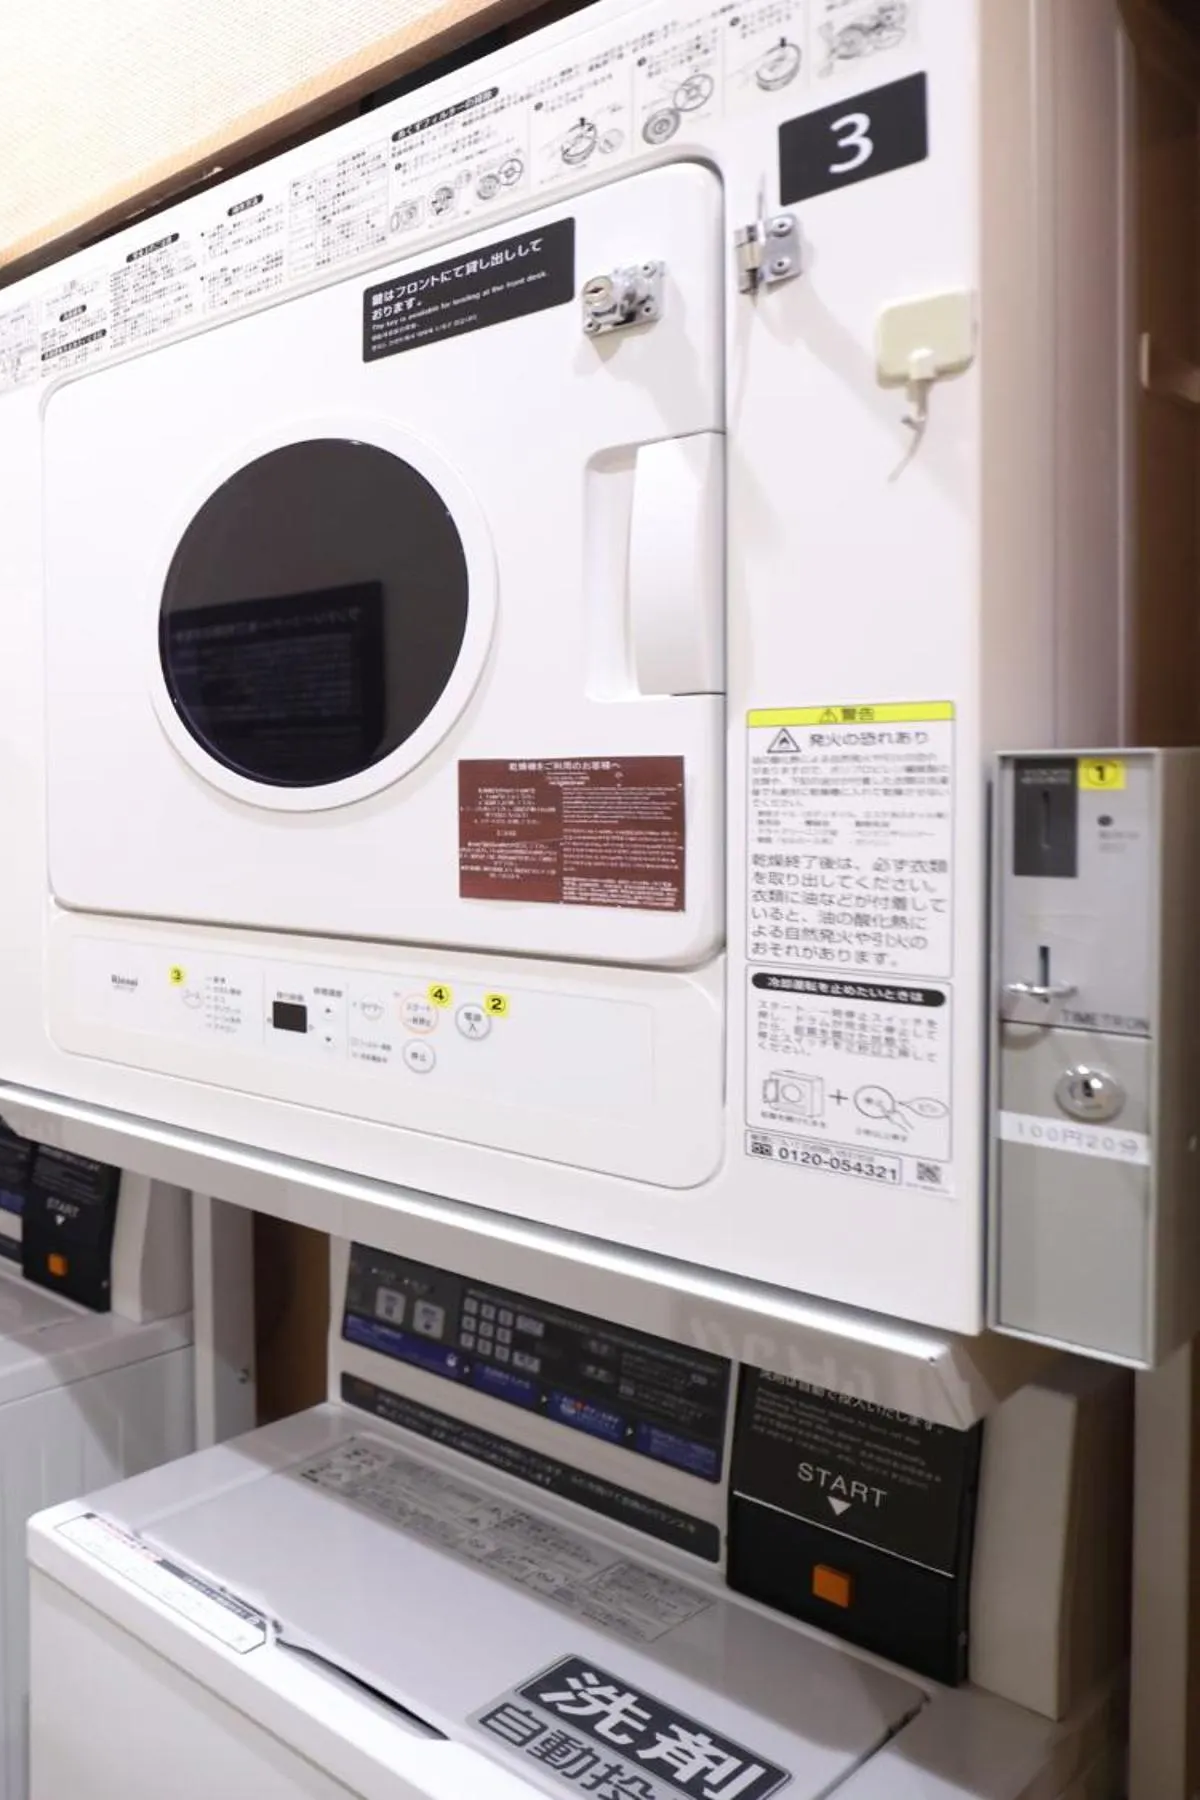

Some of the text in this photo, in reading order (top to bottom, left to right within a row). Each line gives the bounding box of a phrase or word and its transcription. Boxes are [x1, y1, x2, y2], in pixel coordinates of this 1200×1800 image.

[828, 112, 874, 174] 3
[371, 296, 423, 321] おります。
[809, 731, 929, 747] 発火の恐れあり
[778, 1146, 898, 1181] 0120-054321
[797, 1462, 887, 1509] START
[538, 1671, 767, 1800] 洗剤
